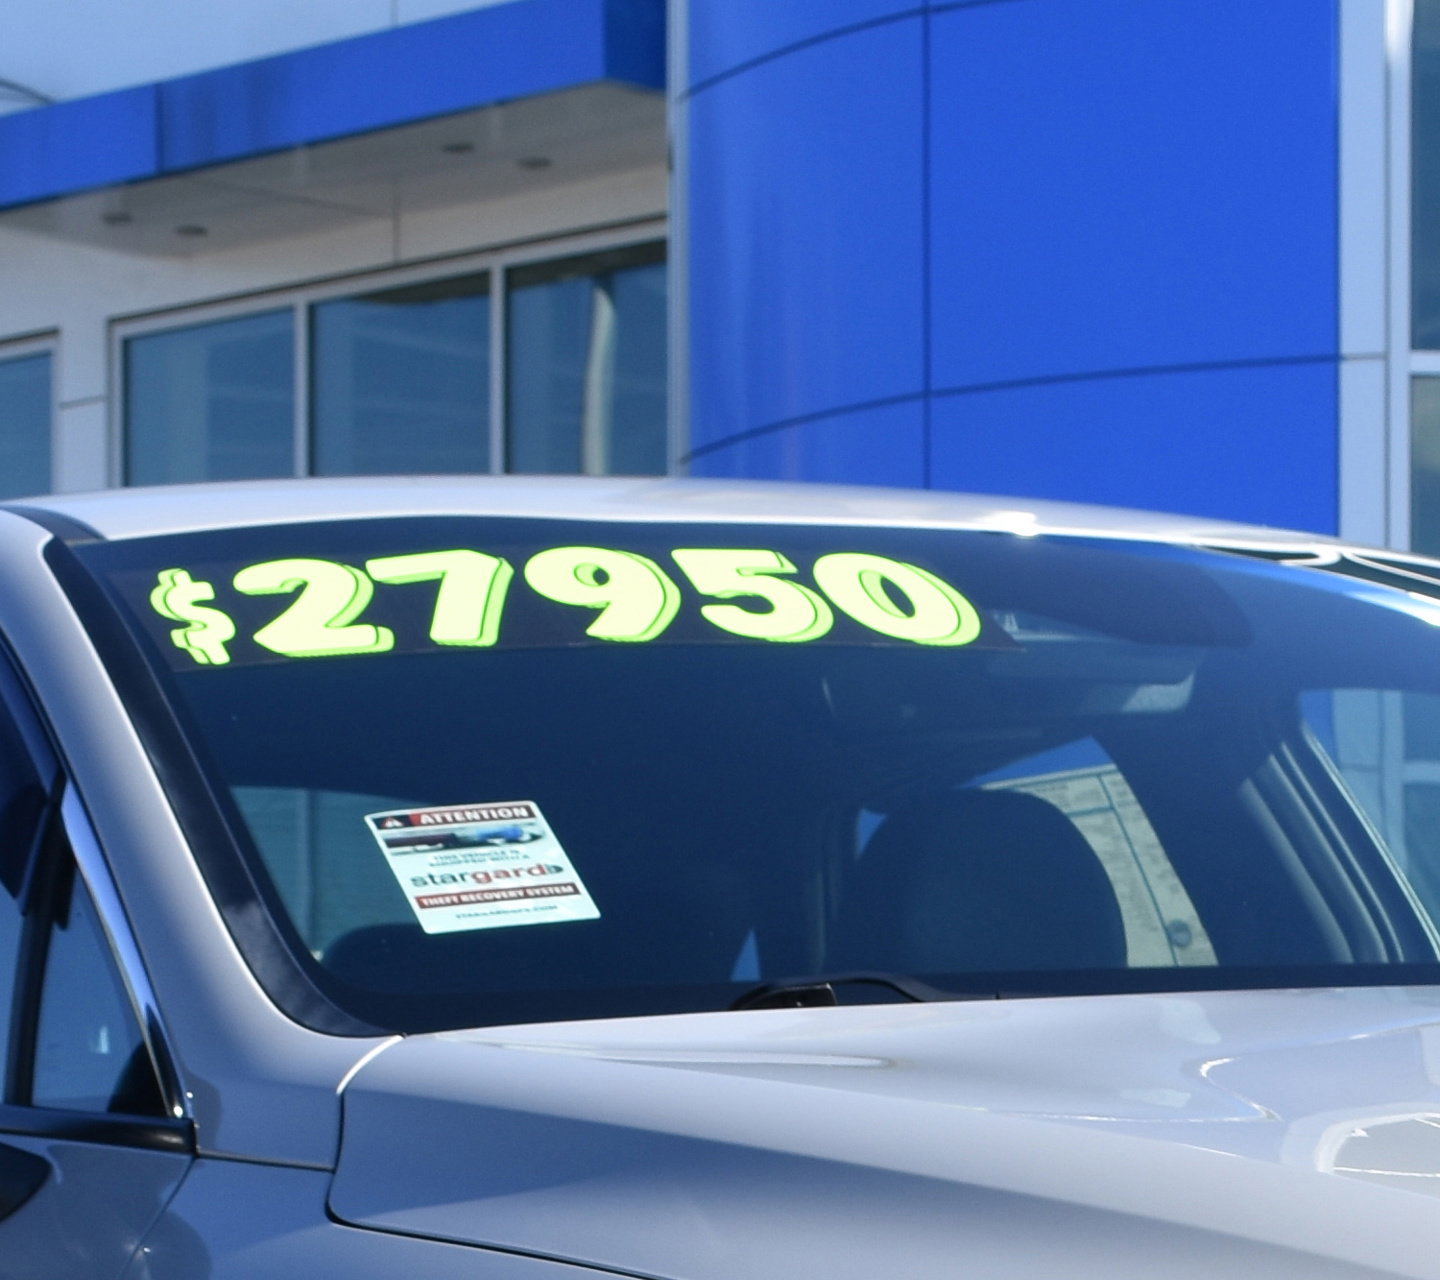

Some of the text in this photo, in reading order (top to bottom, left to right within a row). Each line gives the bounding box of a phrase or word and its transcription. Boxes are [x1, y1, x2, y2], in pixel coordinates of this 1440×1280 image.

[150, 546, 981, 665] $27950
[420, 806, 530, 826] ATTENTION
[420, 884, 575, 907] THEFT RECOVERY SYSTEM
